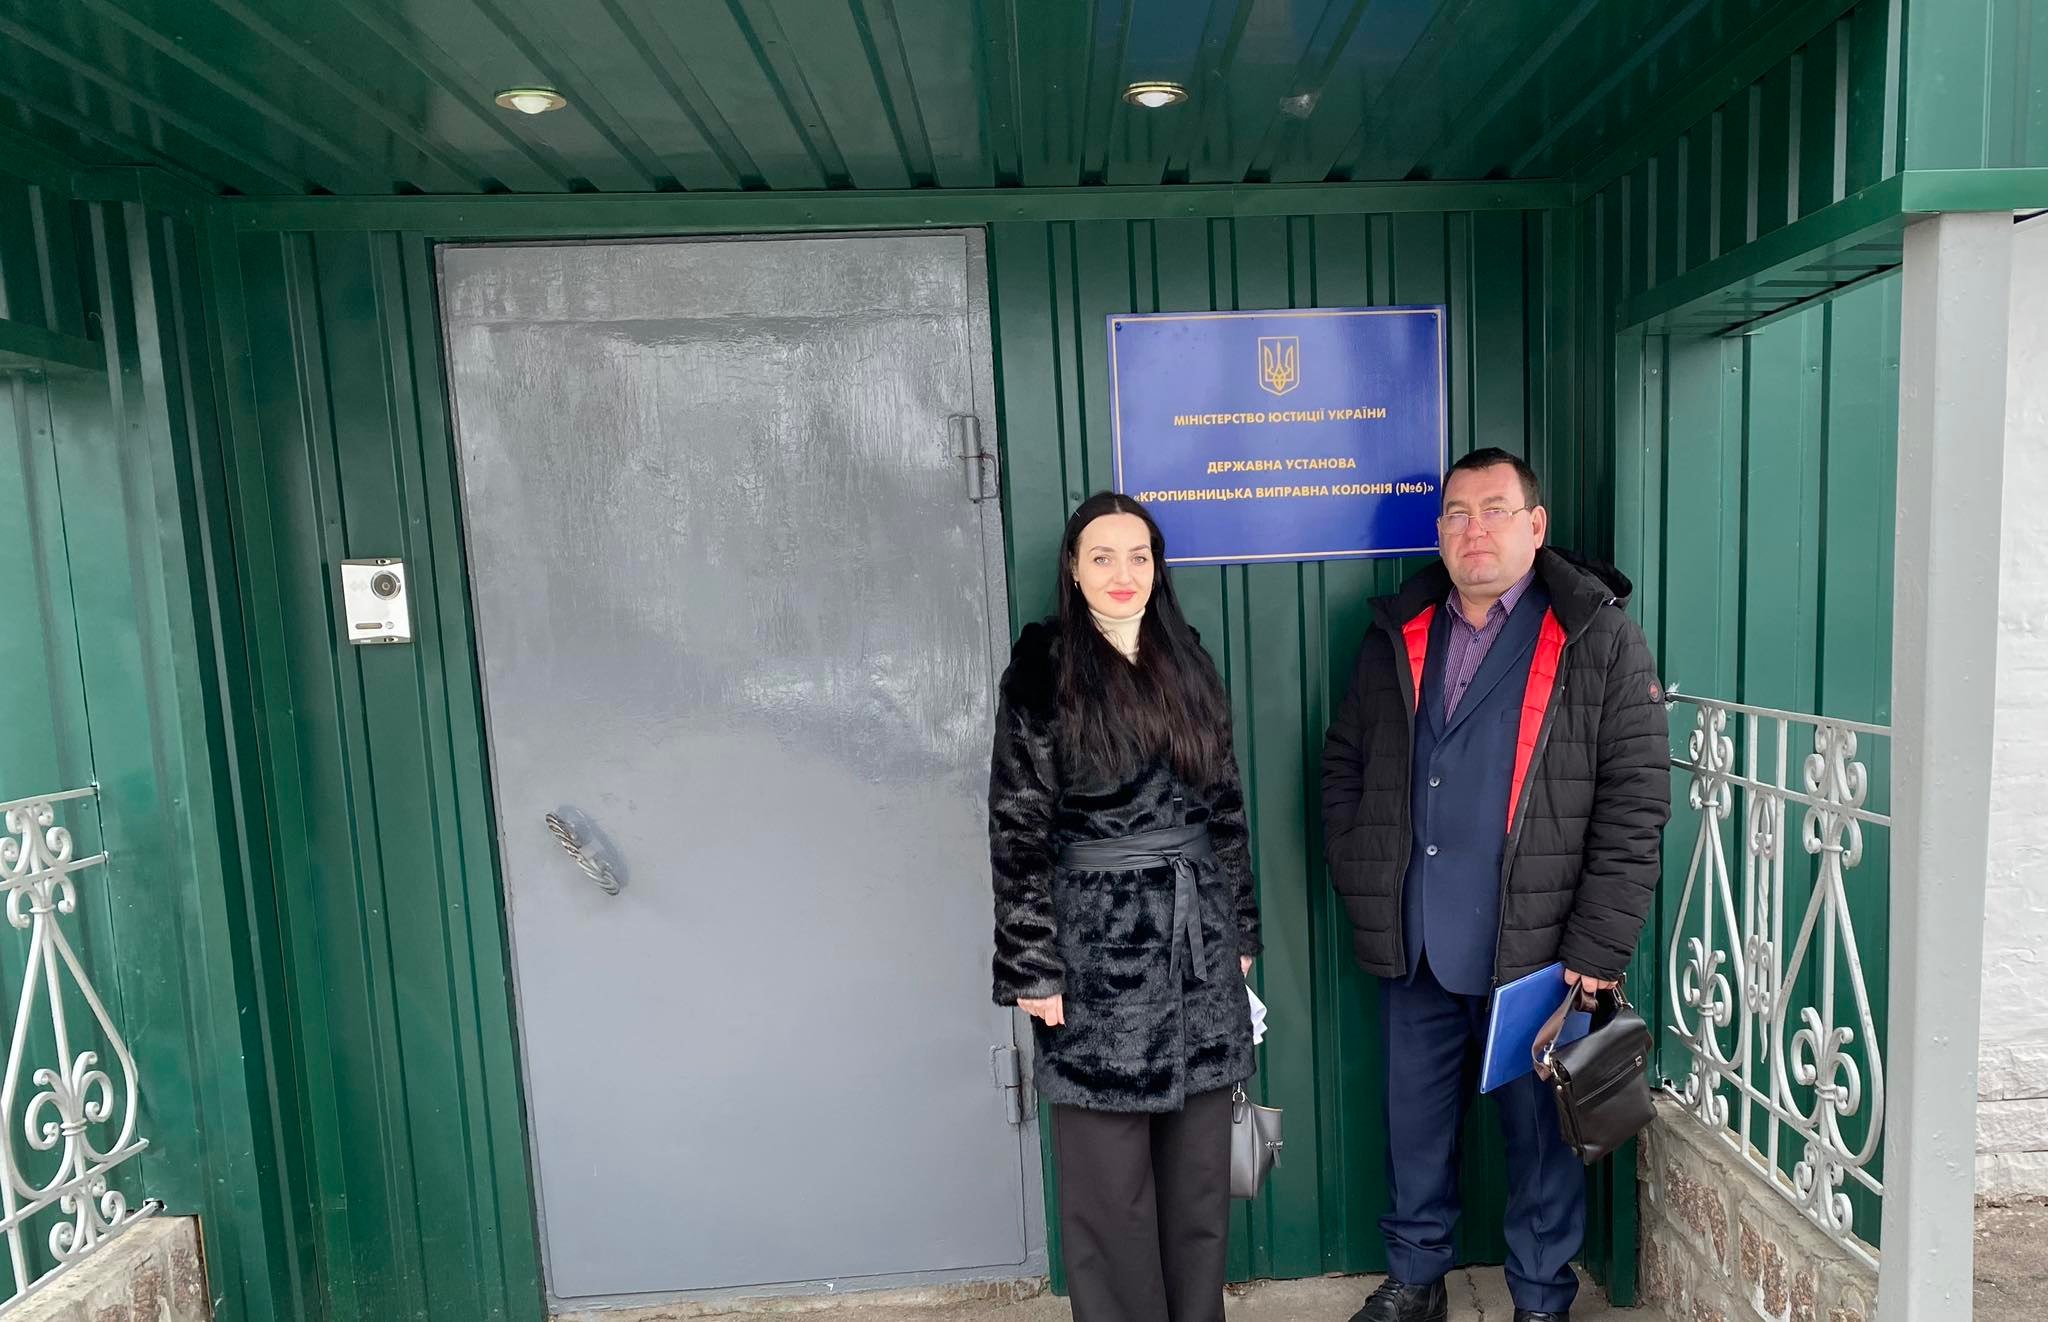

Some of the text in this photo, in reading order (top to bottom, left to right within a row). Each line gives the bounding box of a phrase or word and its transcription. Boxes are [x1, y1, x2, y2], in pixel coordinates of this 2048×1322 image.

[1173, 406, 1387, 426] МІНІСТЕРСТВО ЮСТИЦІЇ УКРАЇНИ
[1207, 458, 1357, 474] ДЕРЖАВНА УСТАНОВА
[1133, 481, 1434, 502] «КРОПИВНИЦЬКА ВИПРАВНА КОЛОНІЯ (№6)»
